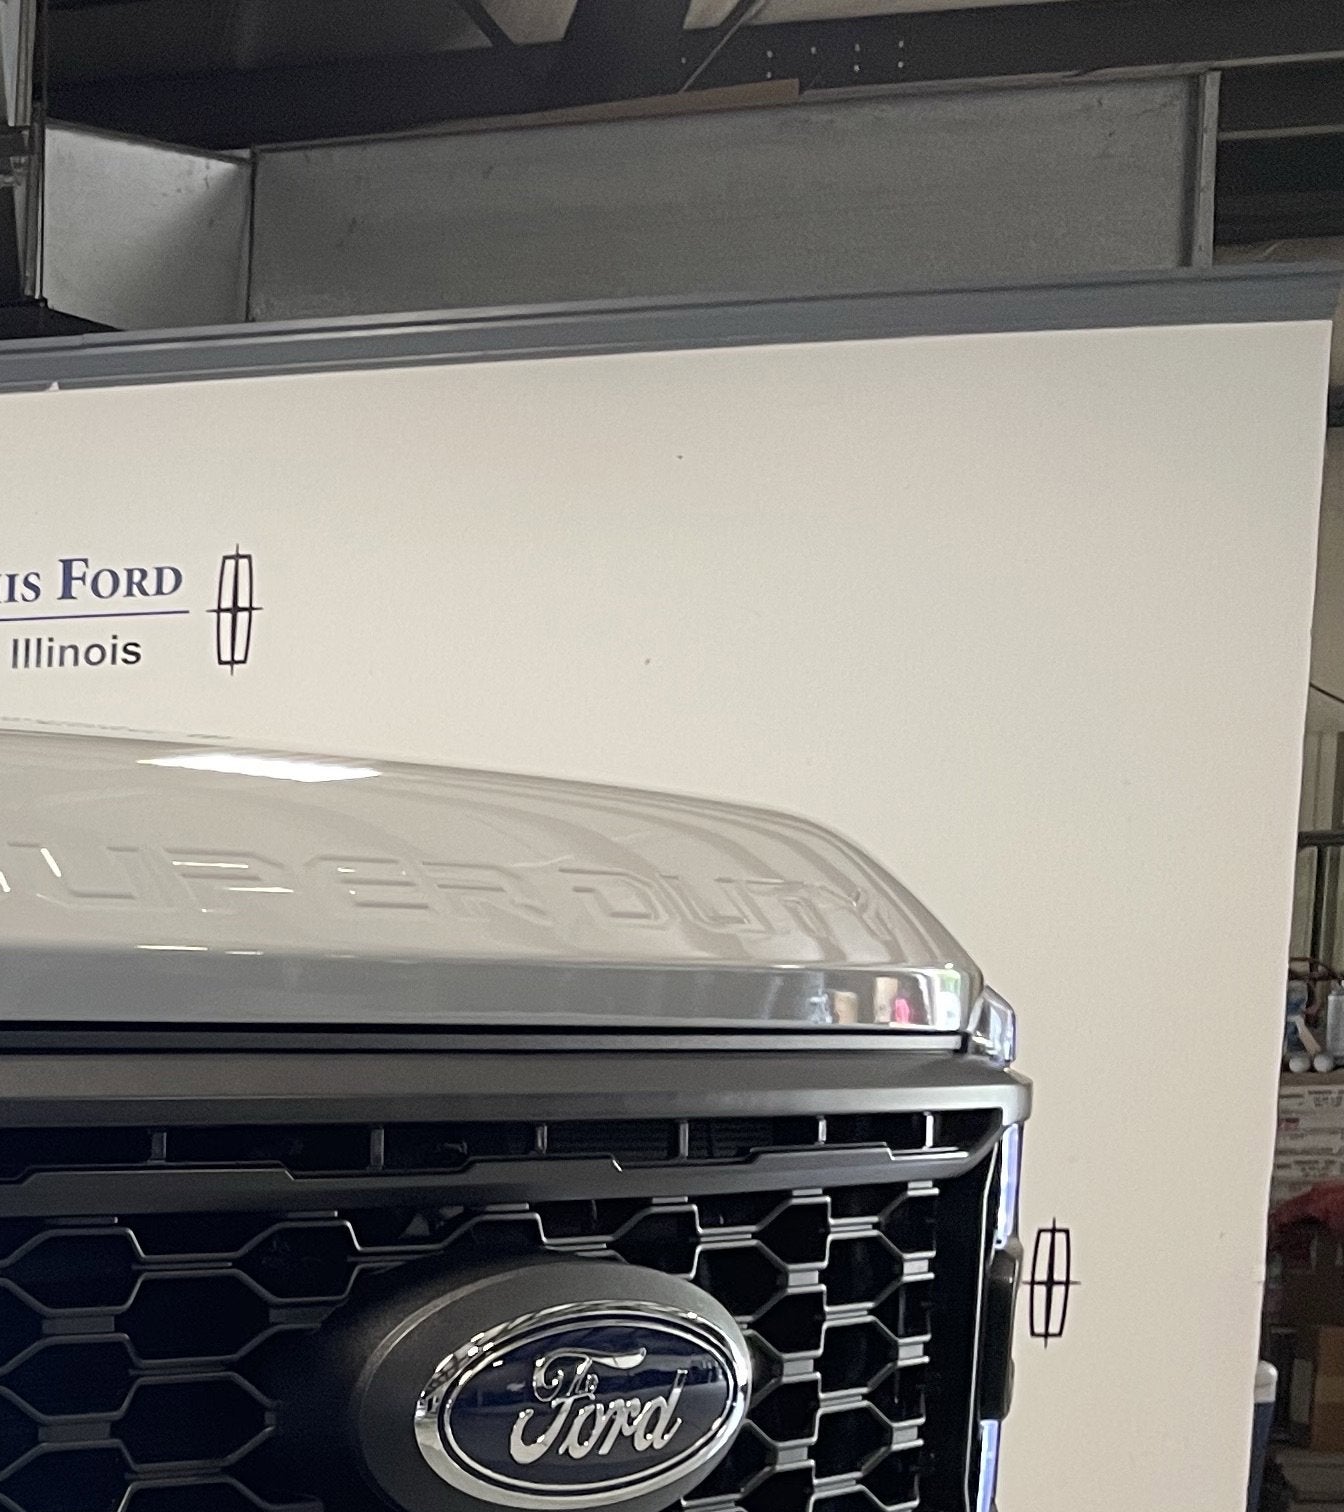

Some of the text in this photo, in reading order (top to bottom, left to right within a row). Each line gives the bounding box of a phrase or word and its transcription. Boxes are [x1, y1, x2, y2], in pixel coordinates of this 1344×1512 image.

[56, 557, 183, 600] FORD
[11, 633, 142, 669] Illinois
[508, 1346, 688, 1465] Ford
